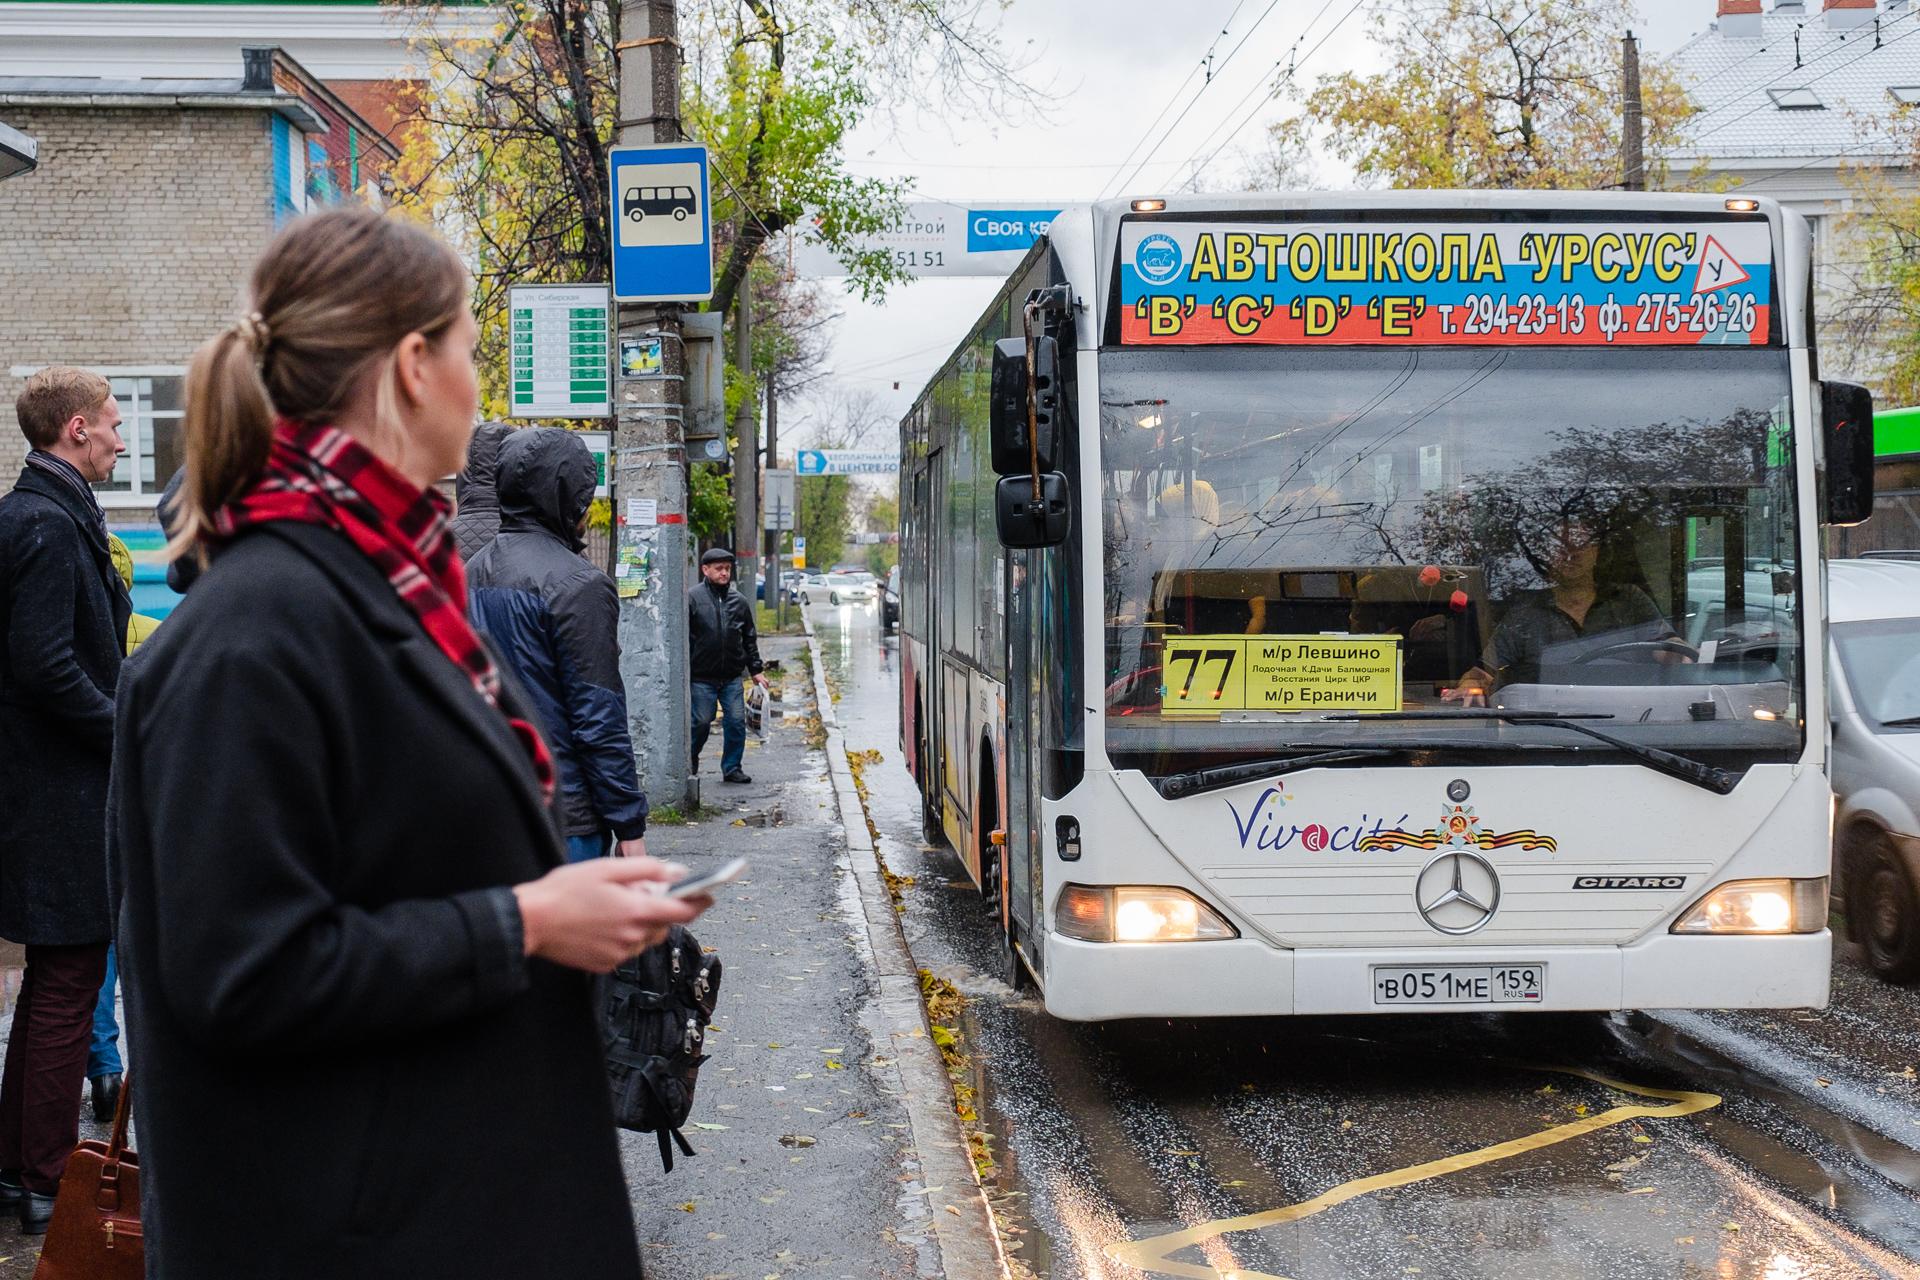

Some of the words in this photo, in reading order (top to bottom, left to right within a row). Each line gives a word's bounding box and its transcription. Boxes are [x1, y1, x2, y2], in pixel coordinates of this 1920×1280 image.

[974, 217, 1024, 236] Своя
[896, 251, 917, 267] 51
[923, 251, 945, 267] 51
[1188, 232, 1504, 283] АВТОШКОЛА
[1438, 304, 1457, 334] т.
[1463, 294, 1585, 335] 294-23-13
[1599, 293, 1629, 342] ф.
[1635, 292, 1757, 333] 275-26-26
[1262, 645, 1292, 662] м/р
[1297, 645, 1381, 659] Левшино
[1169, 649, 1237, 700] 77
[1252, 665, 1297, 674] Лодочная
[1301, 665, 1332, 674] К.Дачи
[1337, 665, 1391, 673] Балмошная
[1271, 675, 1320, 683] Восстания
[1325, 675, 1347, 684] Цирк
[1352, 675, 1371, 684] ЦКР
[1265, 687, 1294, 704] м/р
[1300, 687, 1377, 704] Ераничи
[1578, 878, 1682, 888] CITARO
[1496, 969, 1536, 990] 159
[1504, 990, 1523, 998] RUS
